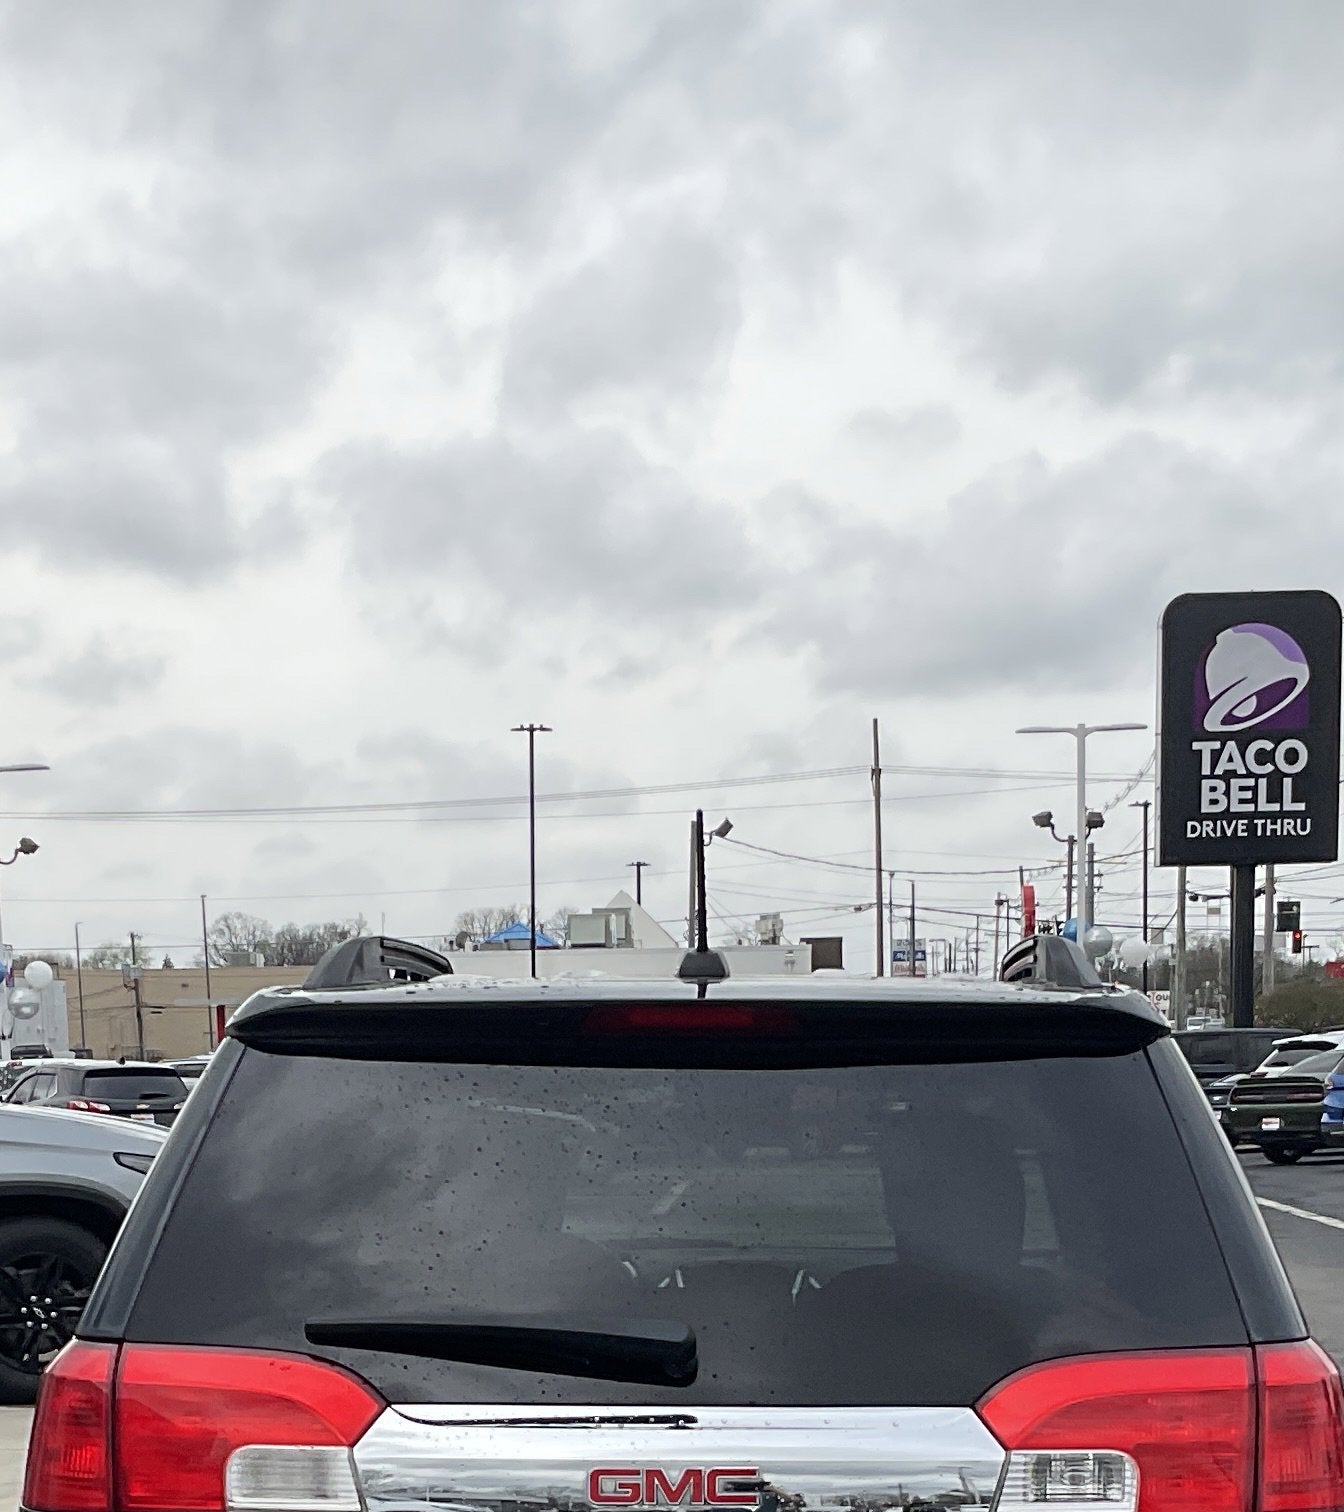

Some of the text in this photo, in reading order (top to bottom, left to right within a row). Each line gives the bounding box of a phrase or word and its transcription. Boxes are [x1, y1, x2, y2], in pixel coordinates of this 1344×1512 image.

[1192, 738, 1308, 776] TACO
[1200, 777, 1306, 814] BELL
[1186, 818, 1312, 838] DRIVE THRU
[588, 1467, 760, 1506] GMC
